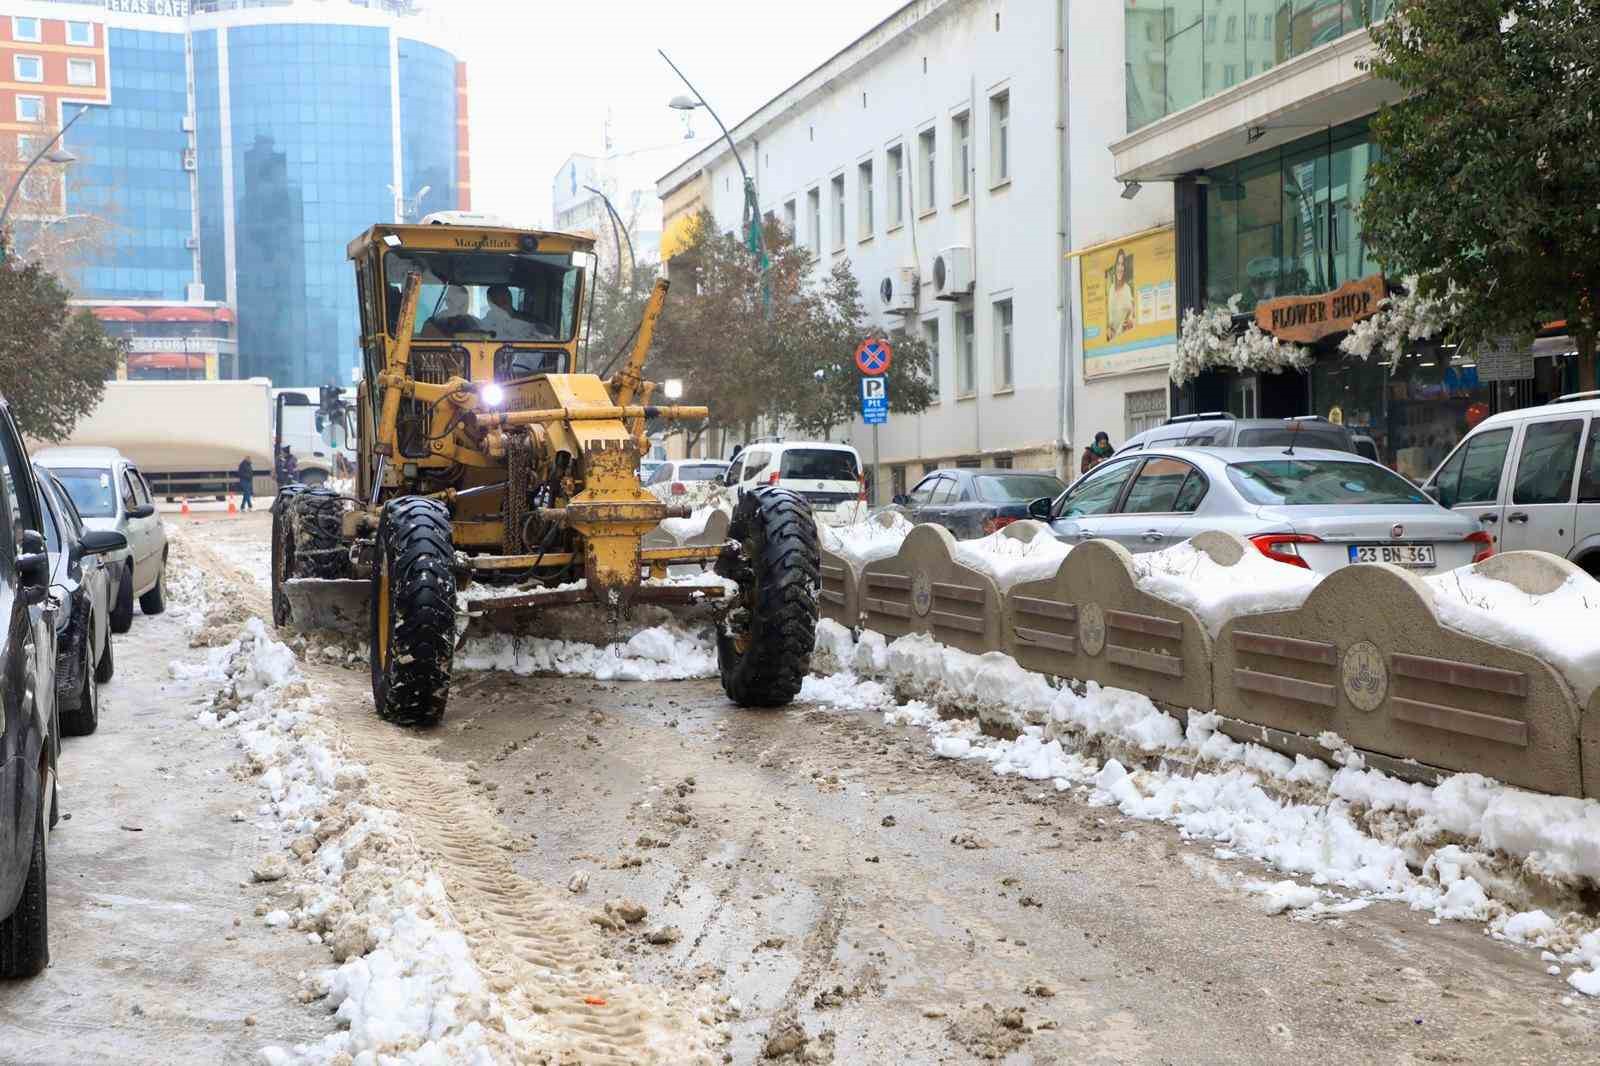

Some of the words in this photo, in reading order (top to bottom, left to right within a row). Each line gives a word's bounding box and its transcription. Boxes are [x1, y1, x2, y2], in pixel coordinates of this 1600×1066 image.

[1271, 301, 1328, 329] FLOWER
[1332, 292, 1371, 318] SHOP
[866, 380, 882, 397] P
[1360, 548, 1377, 562] 23
[1382, 548, 1401, 562] BN
[1408, 548, 1432, 562] 361
